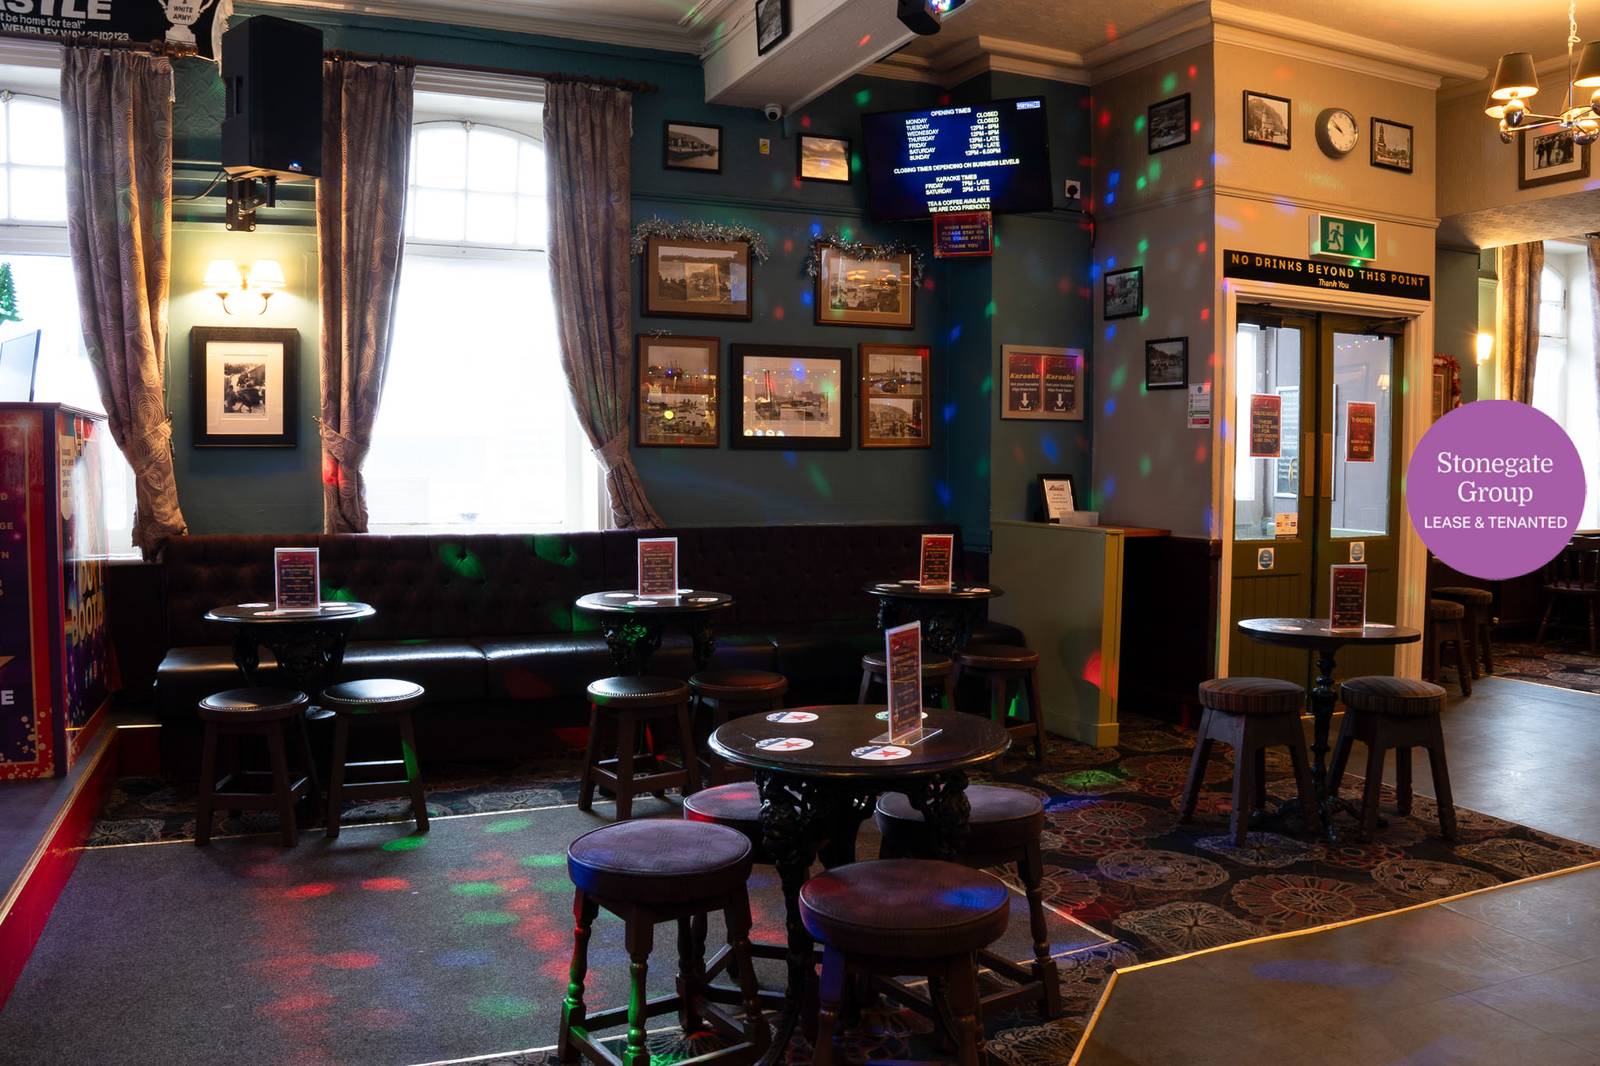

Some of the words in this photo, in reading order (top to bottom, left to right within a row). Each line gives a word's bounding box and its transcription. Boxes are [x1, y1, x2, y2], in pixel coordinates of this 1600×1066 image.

[6, 13, 18, 22] be
[20, 15, 45, 25] home
[47, 18, 60, 27] for
[2, 23, 58, 36] WEMBLEY
[1232, 254, 1249, 265] NO
[1256, 256, 1302, 272] DRINKS
[1308, 264, 1354, 278] BEYOND
[1359, 270, 1386, 282] THIS
[1391, 275, 1424, 287] POINT
[1318, 278, 1337, 288] Thank
[1338, 280, 1349, 289] You
